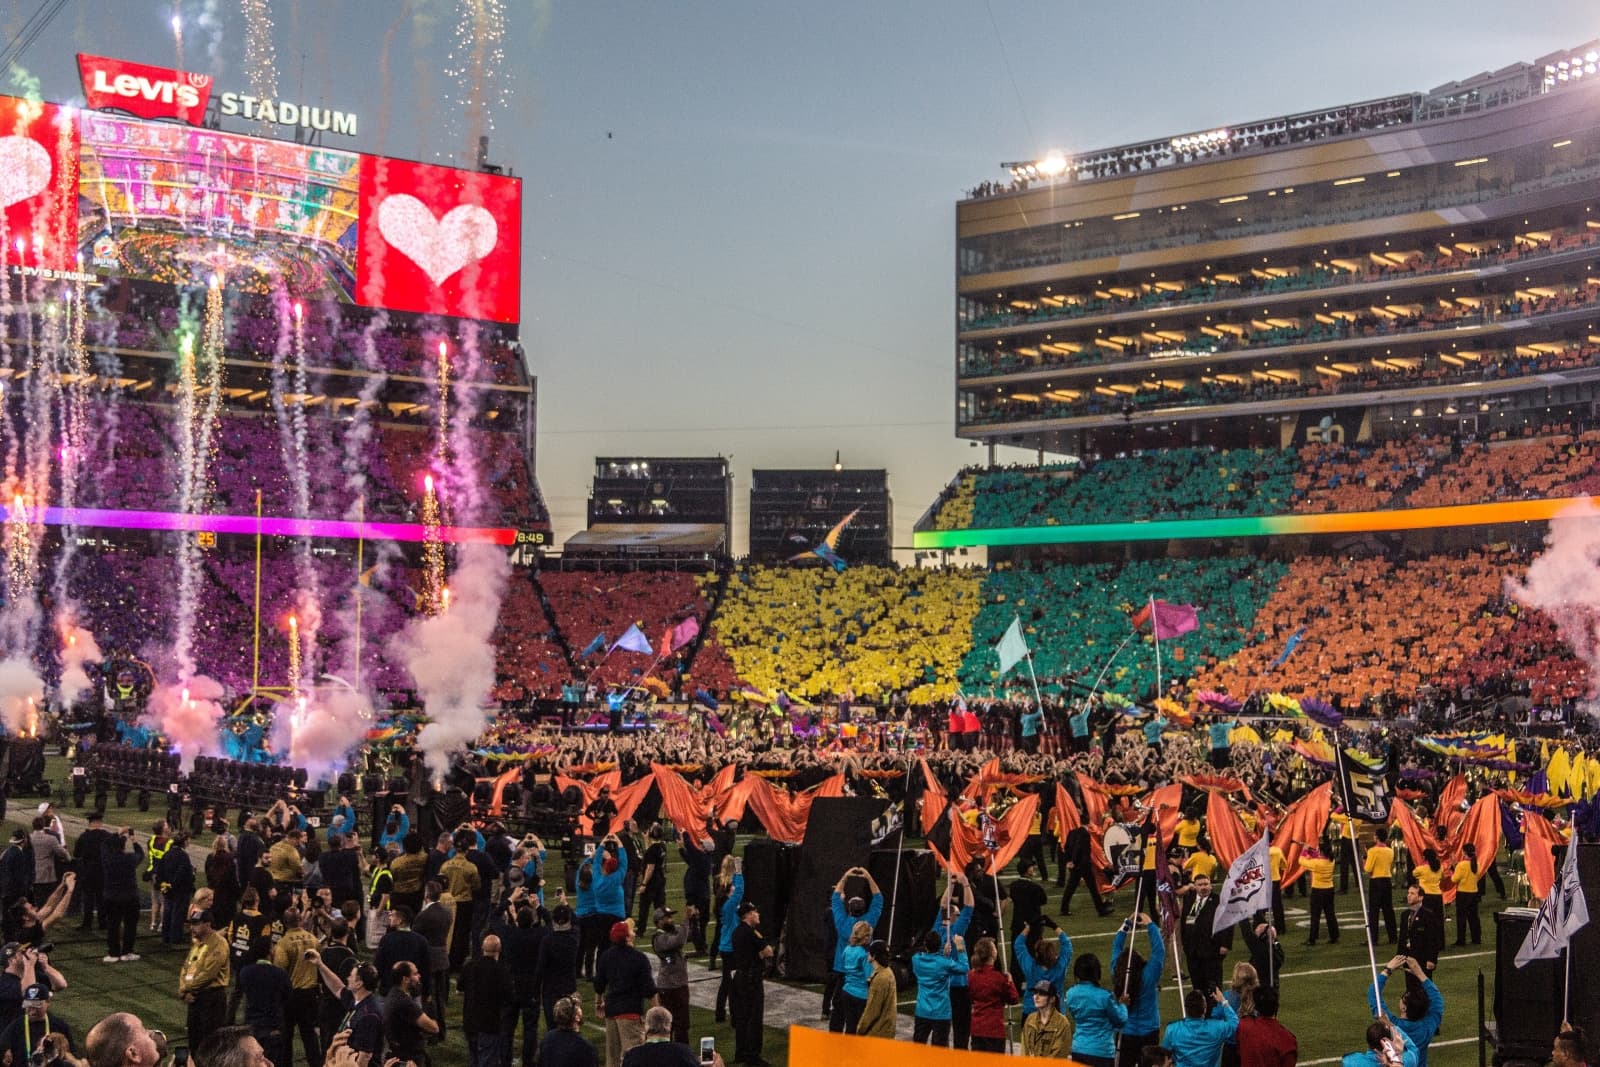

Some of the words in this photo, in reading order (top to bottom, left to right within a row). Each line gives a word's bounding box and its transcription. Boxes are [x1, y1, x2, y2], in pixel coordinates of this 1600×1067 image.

[220, 92, 357, 135] STADIUM
[53, 270, 97, 282] STADIUM
[198, 532, 214, 545] 25
[518, 532, 544, 543] 8:49
